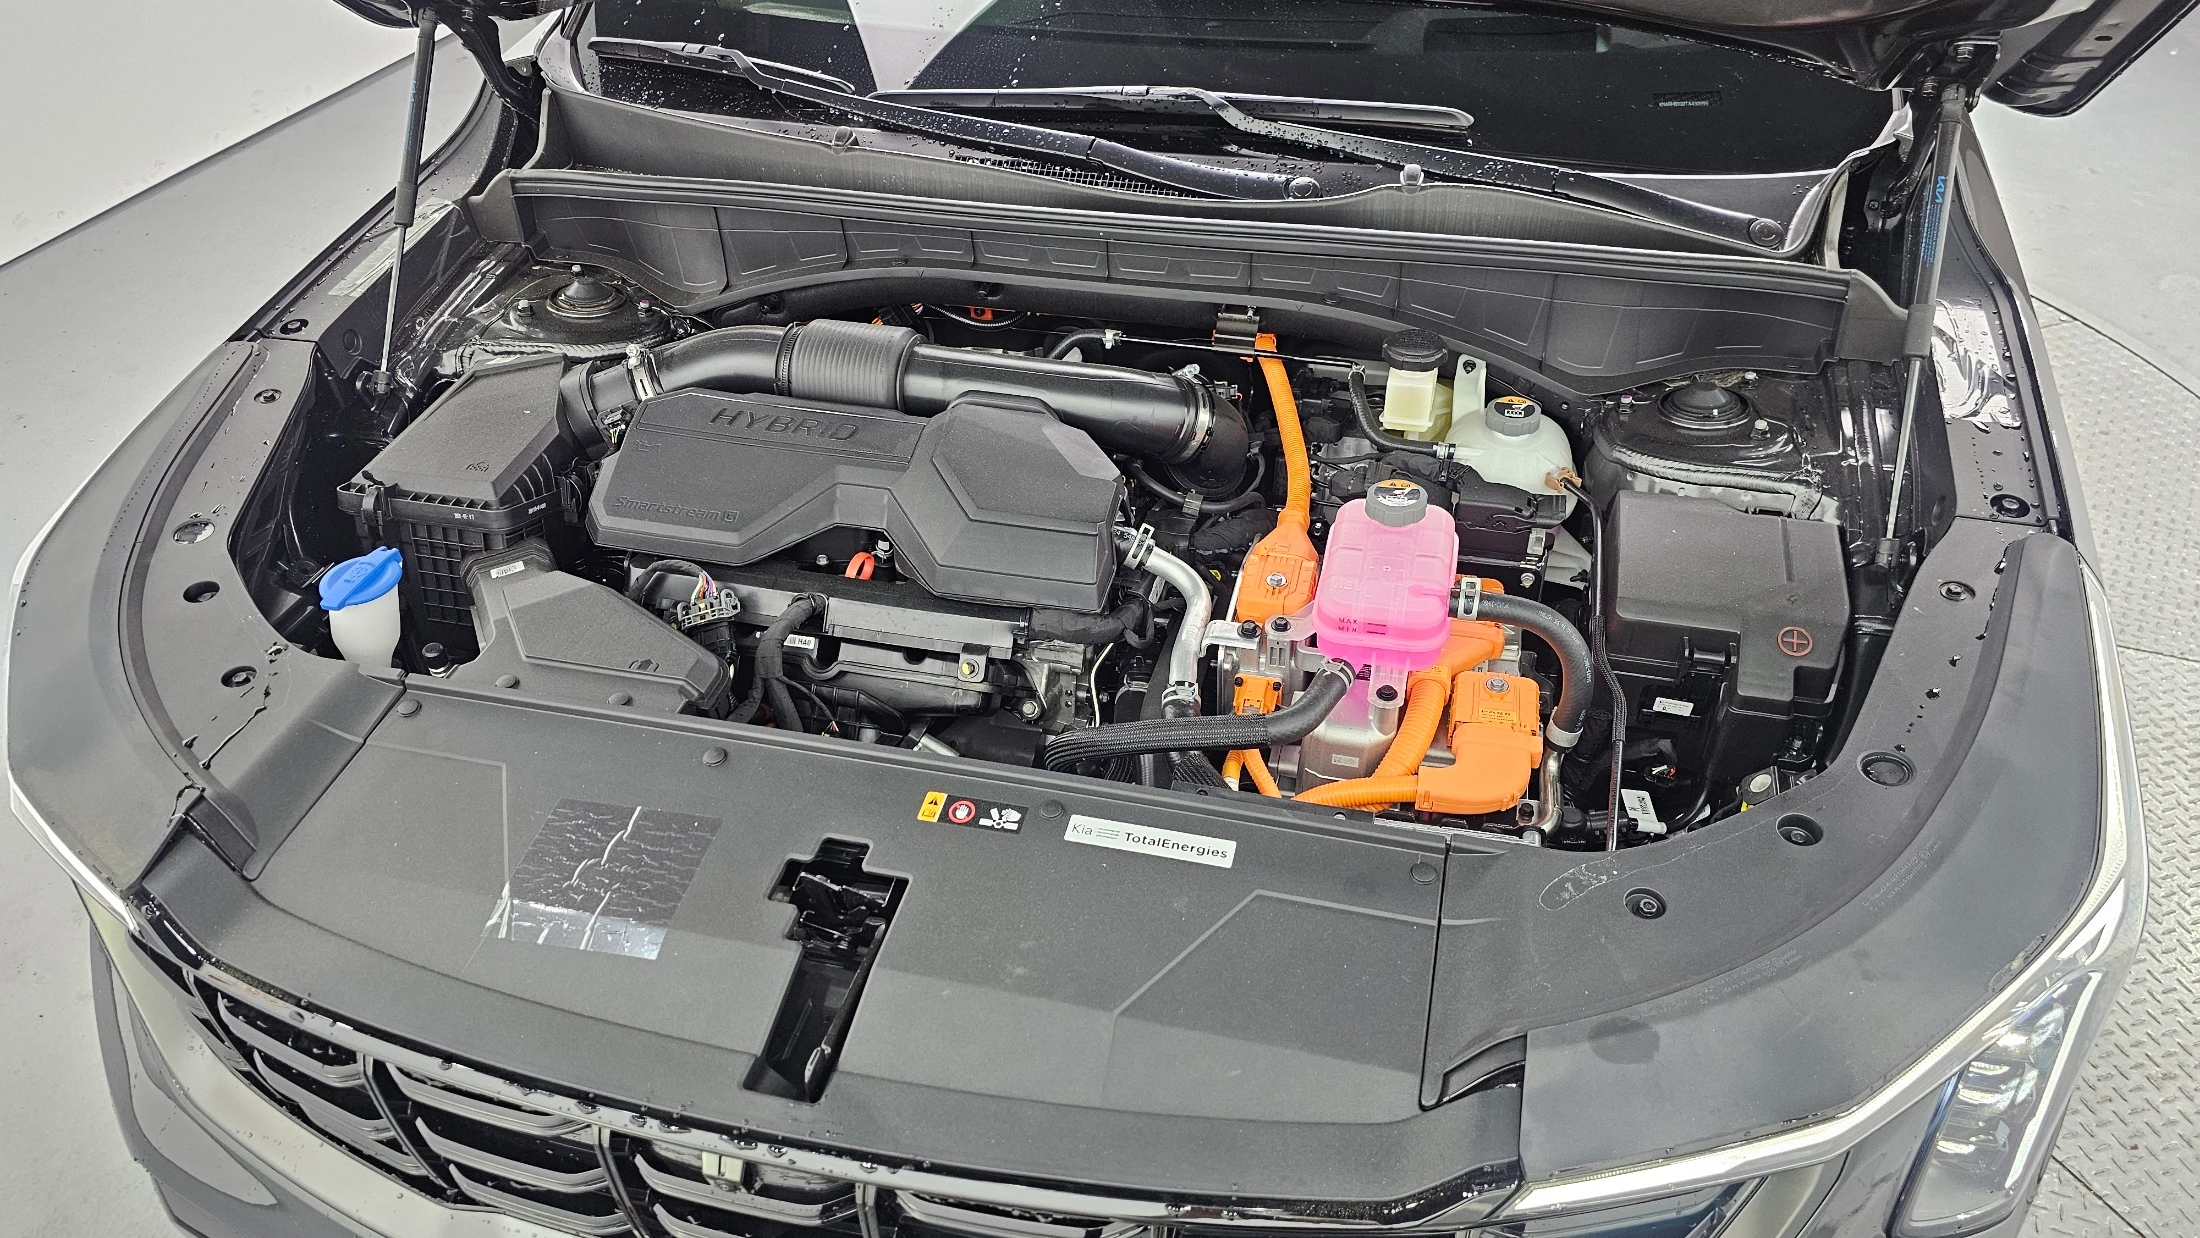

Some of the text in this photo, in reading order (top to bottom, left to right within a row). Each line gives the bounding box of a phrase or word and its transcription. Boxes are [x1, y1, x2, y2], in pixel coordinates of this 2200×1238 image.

[708, 407, 860, 441] HYBRID
[614, 495, 739, 523] Smartstream G
[1338, 617, 1358, 625] MAX
[1071, 822, 1228, 859] Kia TotalEnergies
